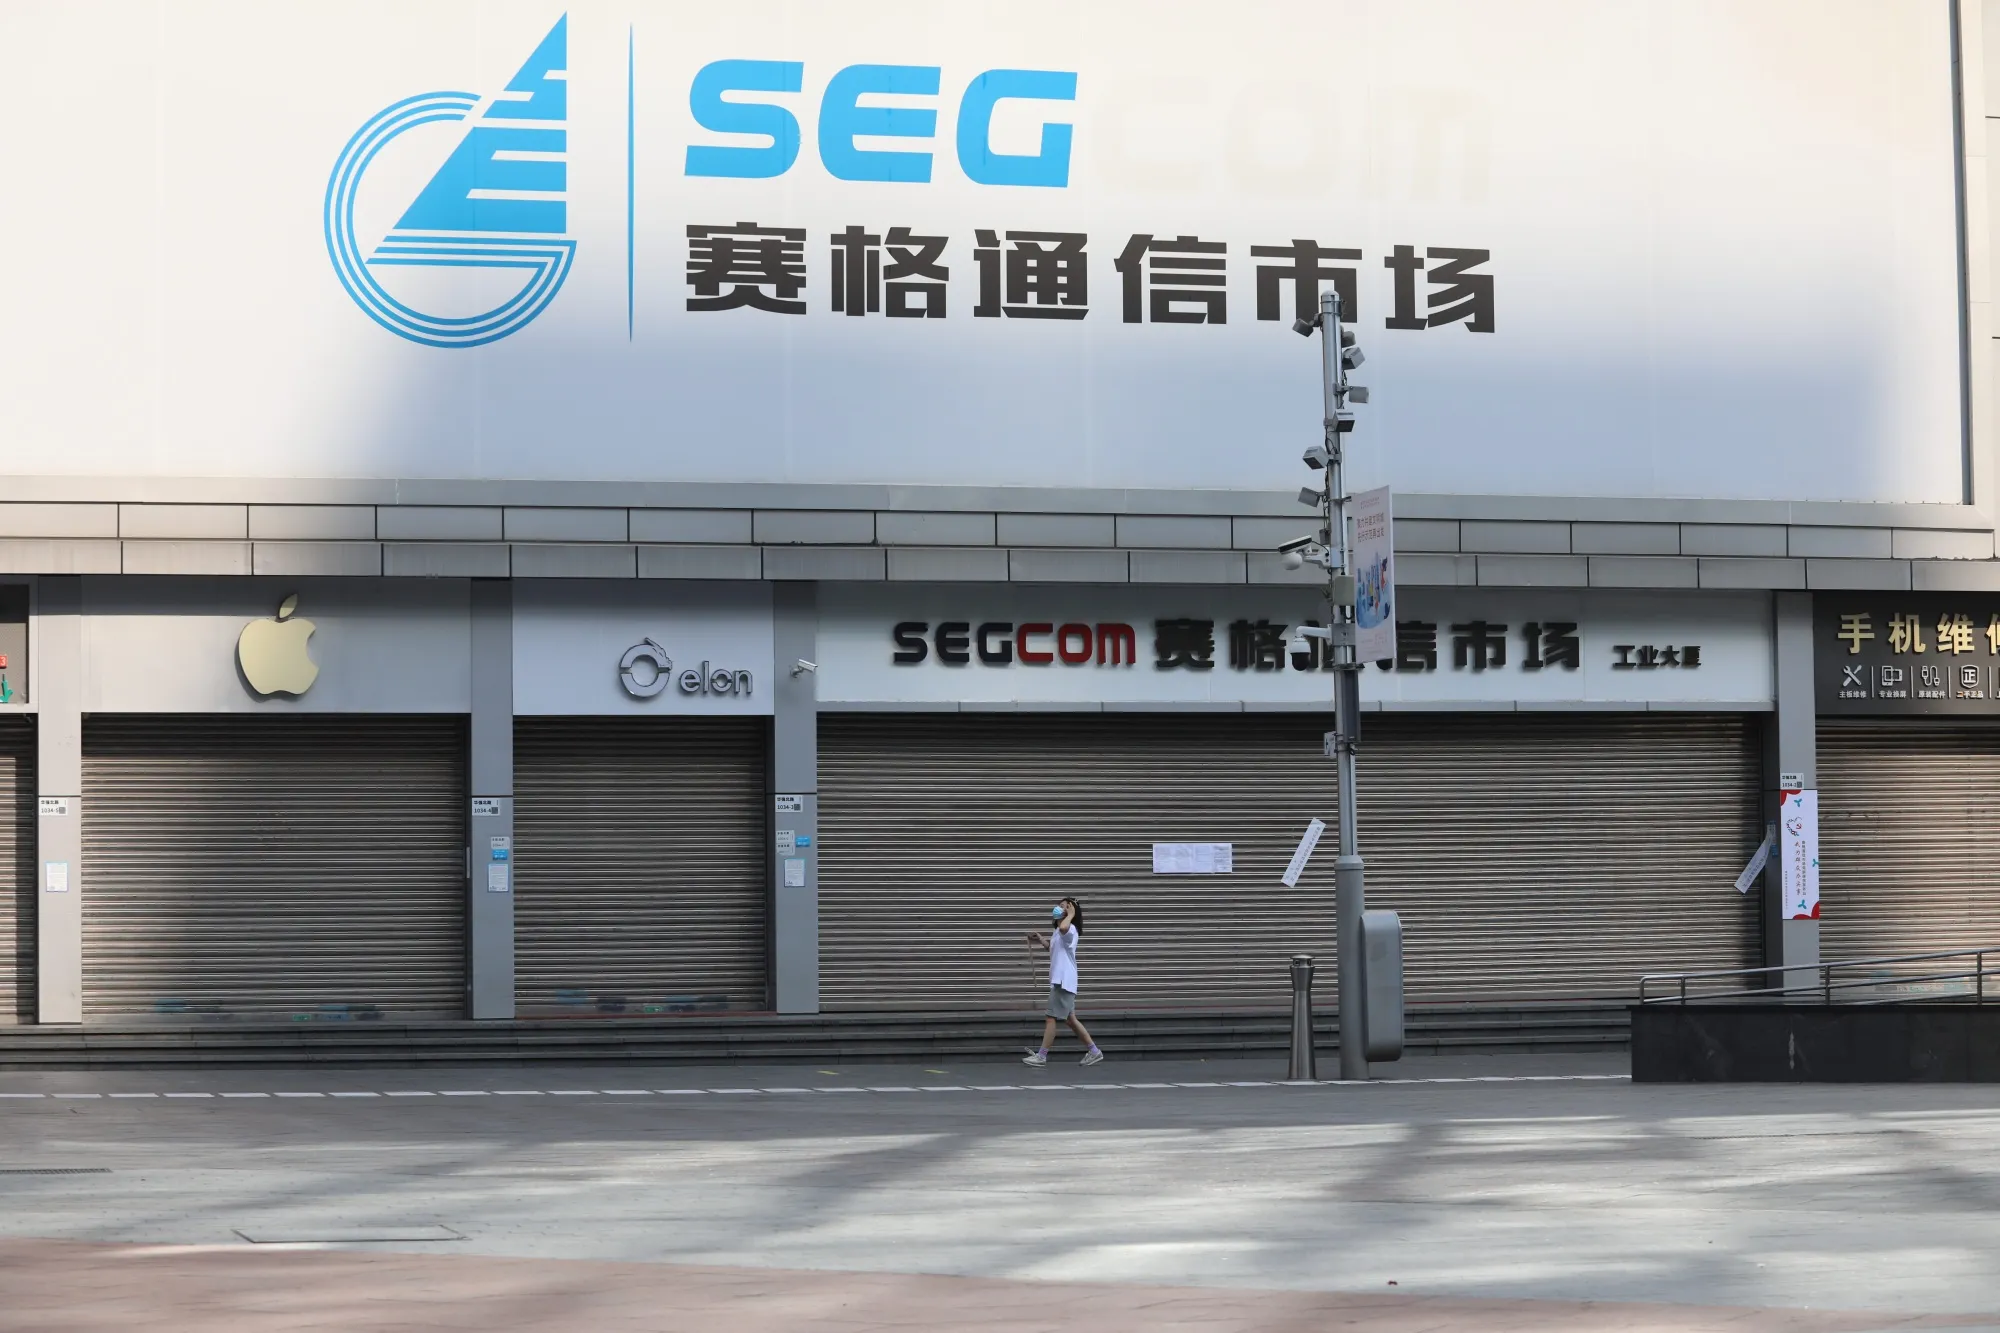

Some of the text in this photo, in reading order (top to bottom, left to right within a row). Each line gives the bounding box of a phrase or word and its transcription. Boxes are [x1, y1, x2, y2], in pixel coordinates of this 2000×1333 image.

[684, 59, 1077, 188] SEG
[685, 221, 1495, 334] 赛格通信市场
[1613, 644, 1702, 668] 工业大厦
[678, 660, 753, 694] elon
[1839, 690, 1984, 699] 主板维修 专业换屏 原装配件 二手正品
